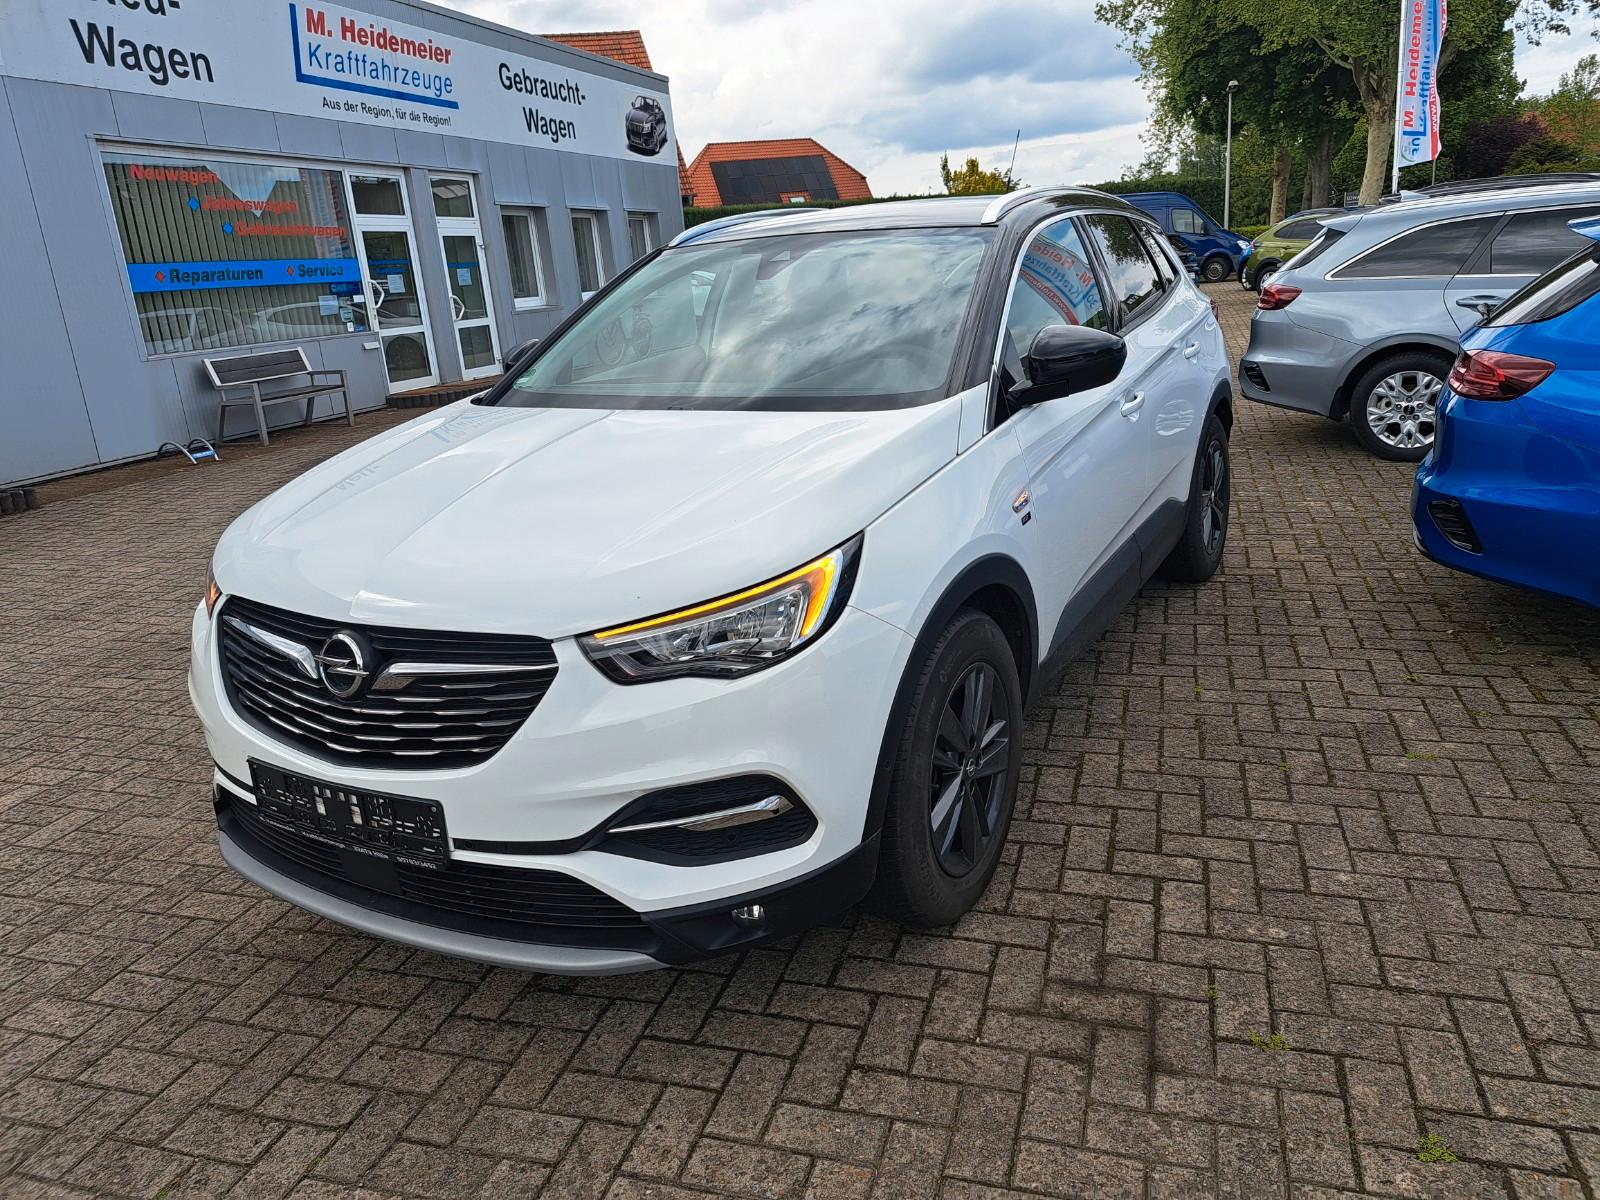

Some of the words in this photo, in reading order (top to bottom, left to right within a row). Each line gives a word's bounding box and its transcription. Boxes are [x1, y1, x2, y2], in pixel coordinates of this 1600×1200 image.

[68, 18, 214, 86] Wagen
[305, 8, 333, 37] M.
[340, 16, 452, 65] Heidemeier
[308, 42, 453, 97] Kraftfahrzeuge
[498, 63, 586, 106] Gebraucht-
[322, 97, 341, 112] Aus
[343, 99, 358, 114] der
[361, 101, 395, 120] Region,
[395, 108, 407, 120] für
[409, 109, 421, 123] die
[423, 111, 452, 127] Region!
[522, 107, 576, 144] Wagen
[130, 164, 218, 185] Neuwagen
[201, 196, 298, 215] Jahreswagen
[169, 267, 264, 286] Reparaturen
[297, 264, 344, 278] Service
